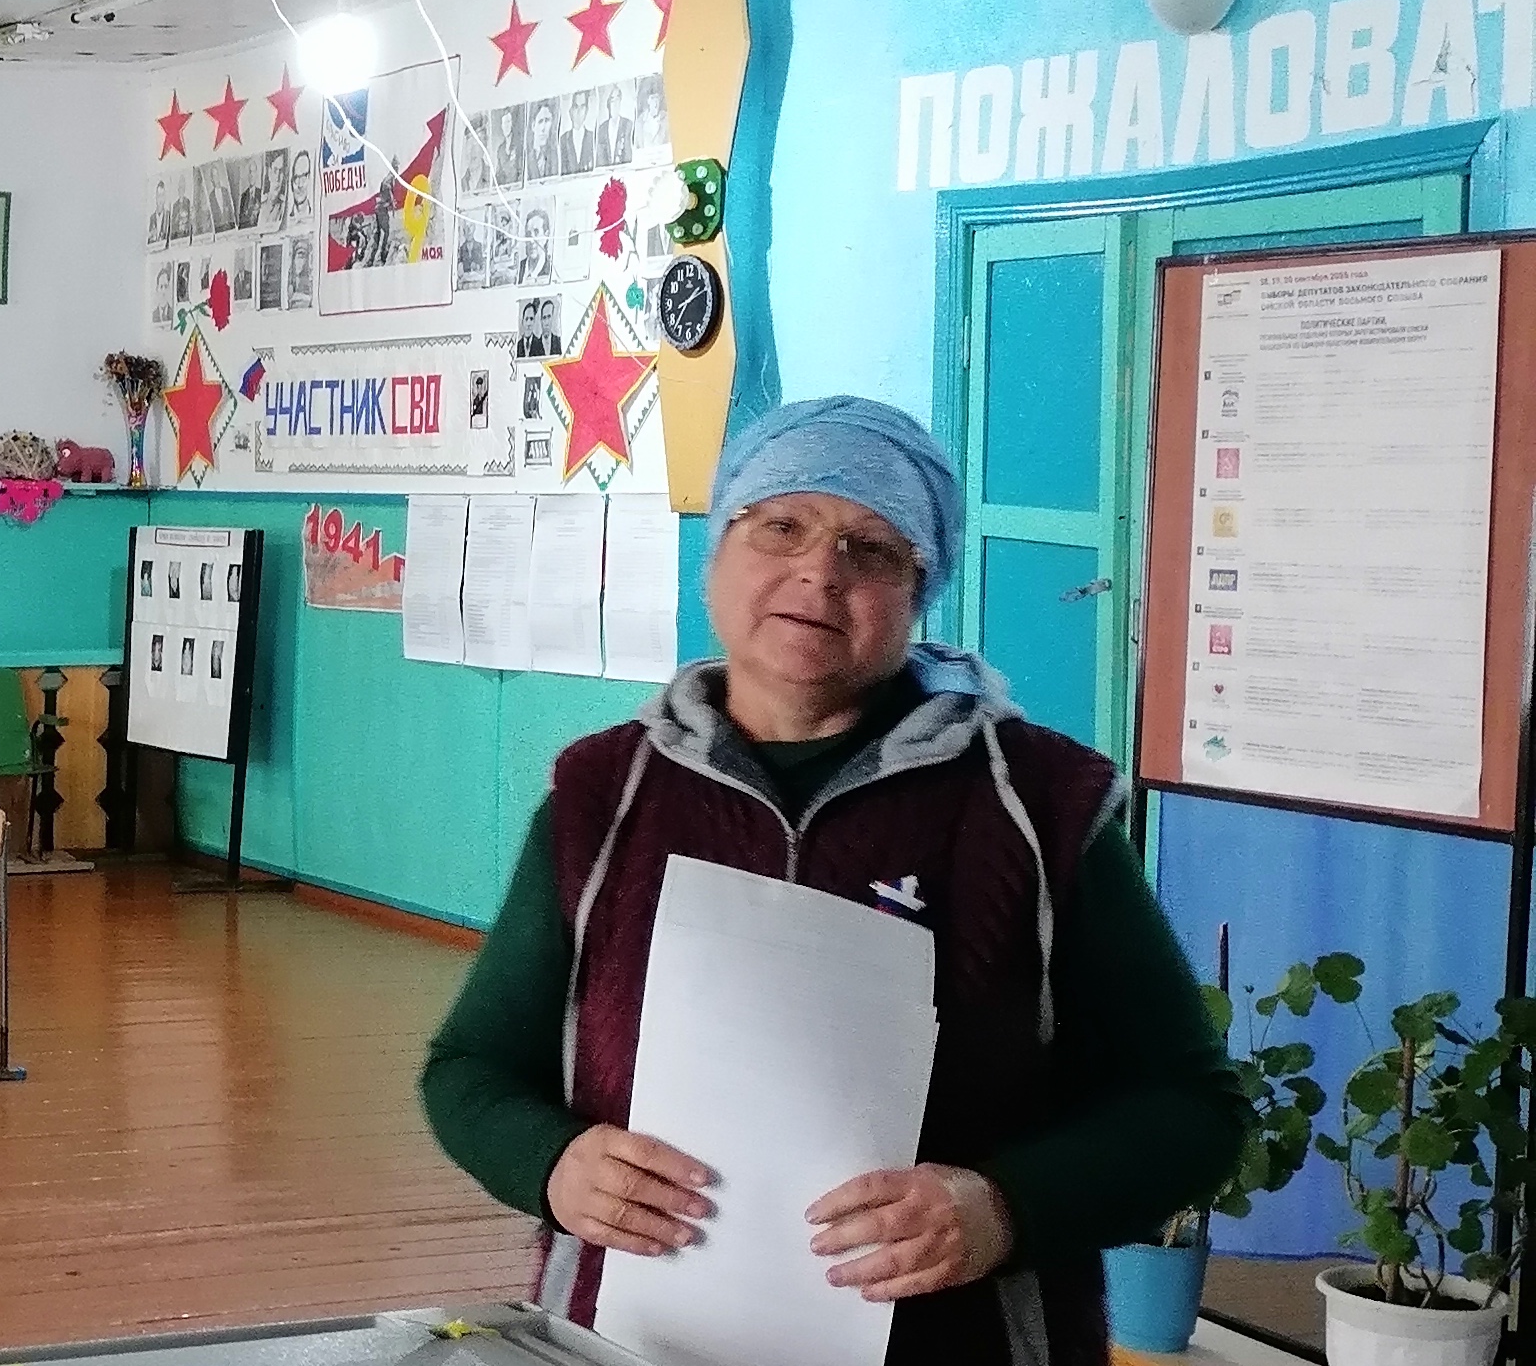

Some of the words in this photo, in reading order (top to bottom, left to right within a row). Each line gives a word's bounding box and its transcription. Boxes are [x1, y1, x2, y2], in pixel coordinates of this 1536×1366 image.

[323, 164, 367, 196] ПОБЕДУ!
[677, 269, 684, 281] 11
[686, 265, 694, 277] 12
[670, 281, 678, 294] 10
[1298, 286, 1344, 298] ДЕПУТАТОВ
[667, 298, 672, 310] 9
[670, 313, 675, 325] 8
[677, 325, 682, 337] 7
[686, 327, 691, 340] 6
[265, 377, 388, 436] УЧАСТНИК
[391, 374, 443, 435] СВО
[306, 501, 381, 572] 1941
